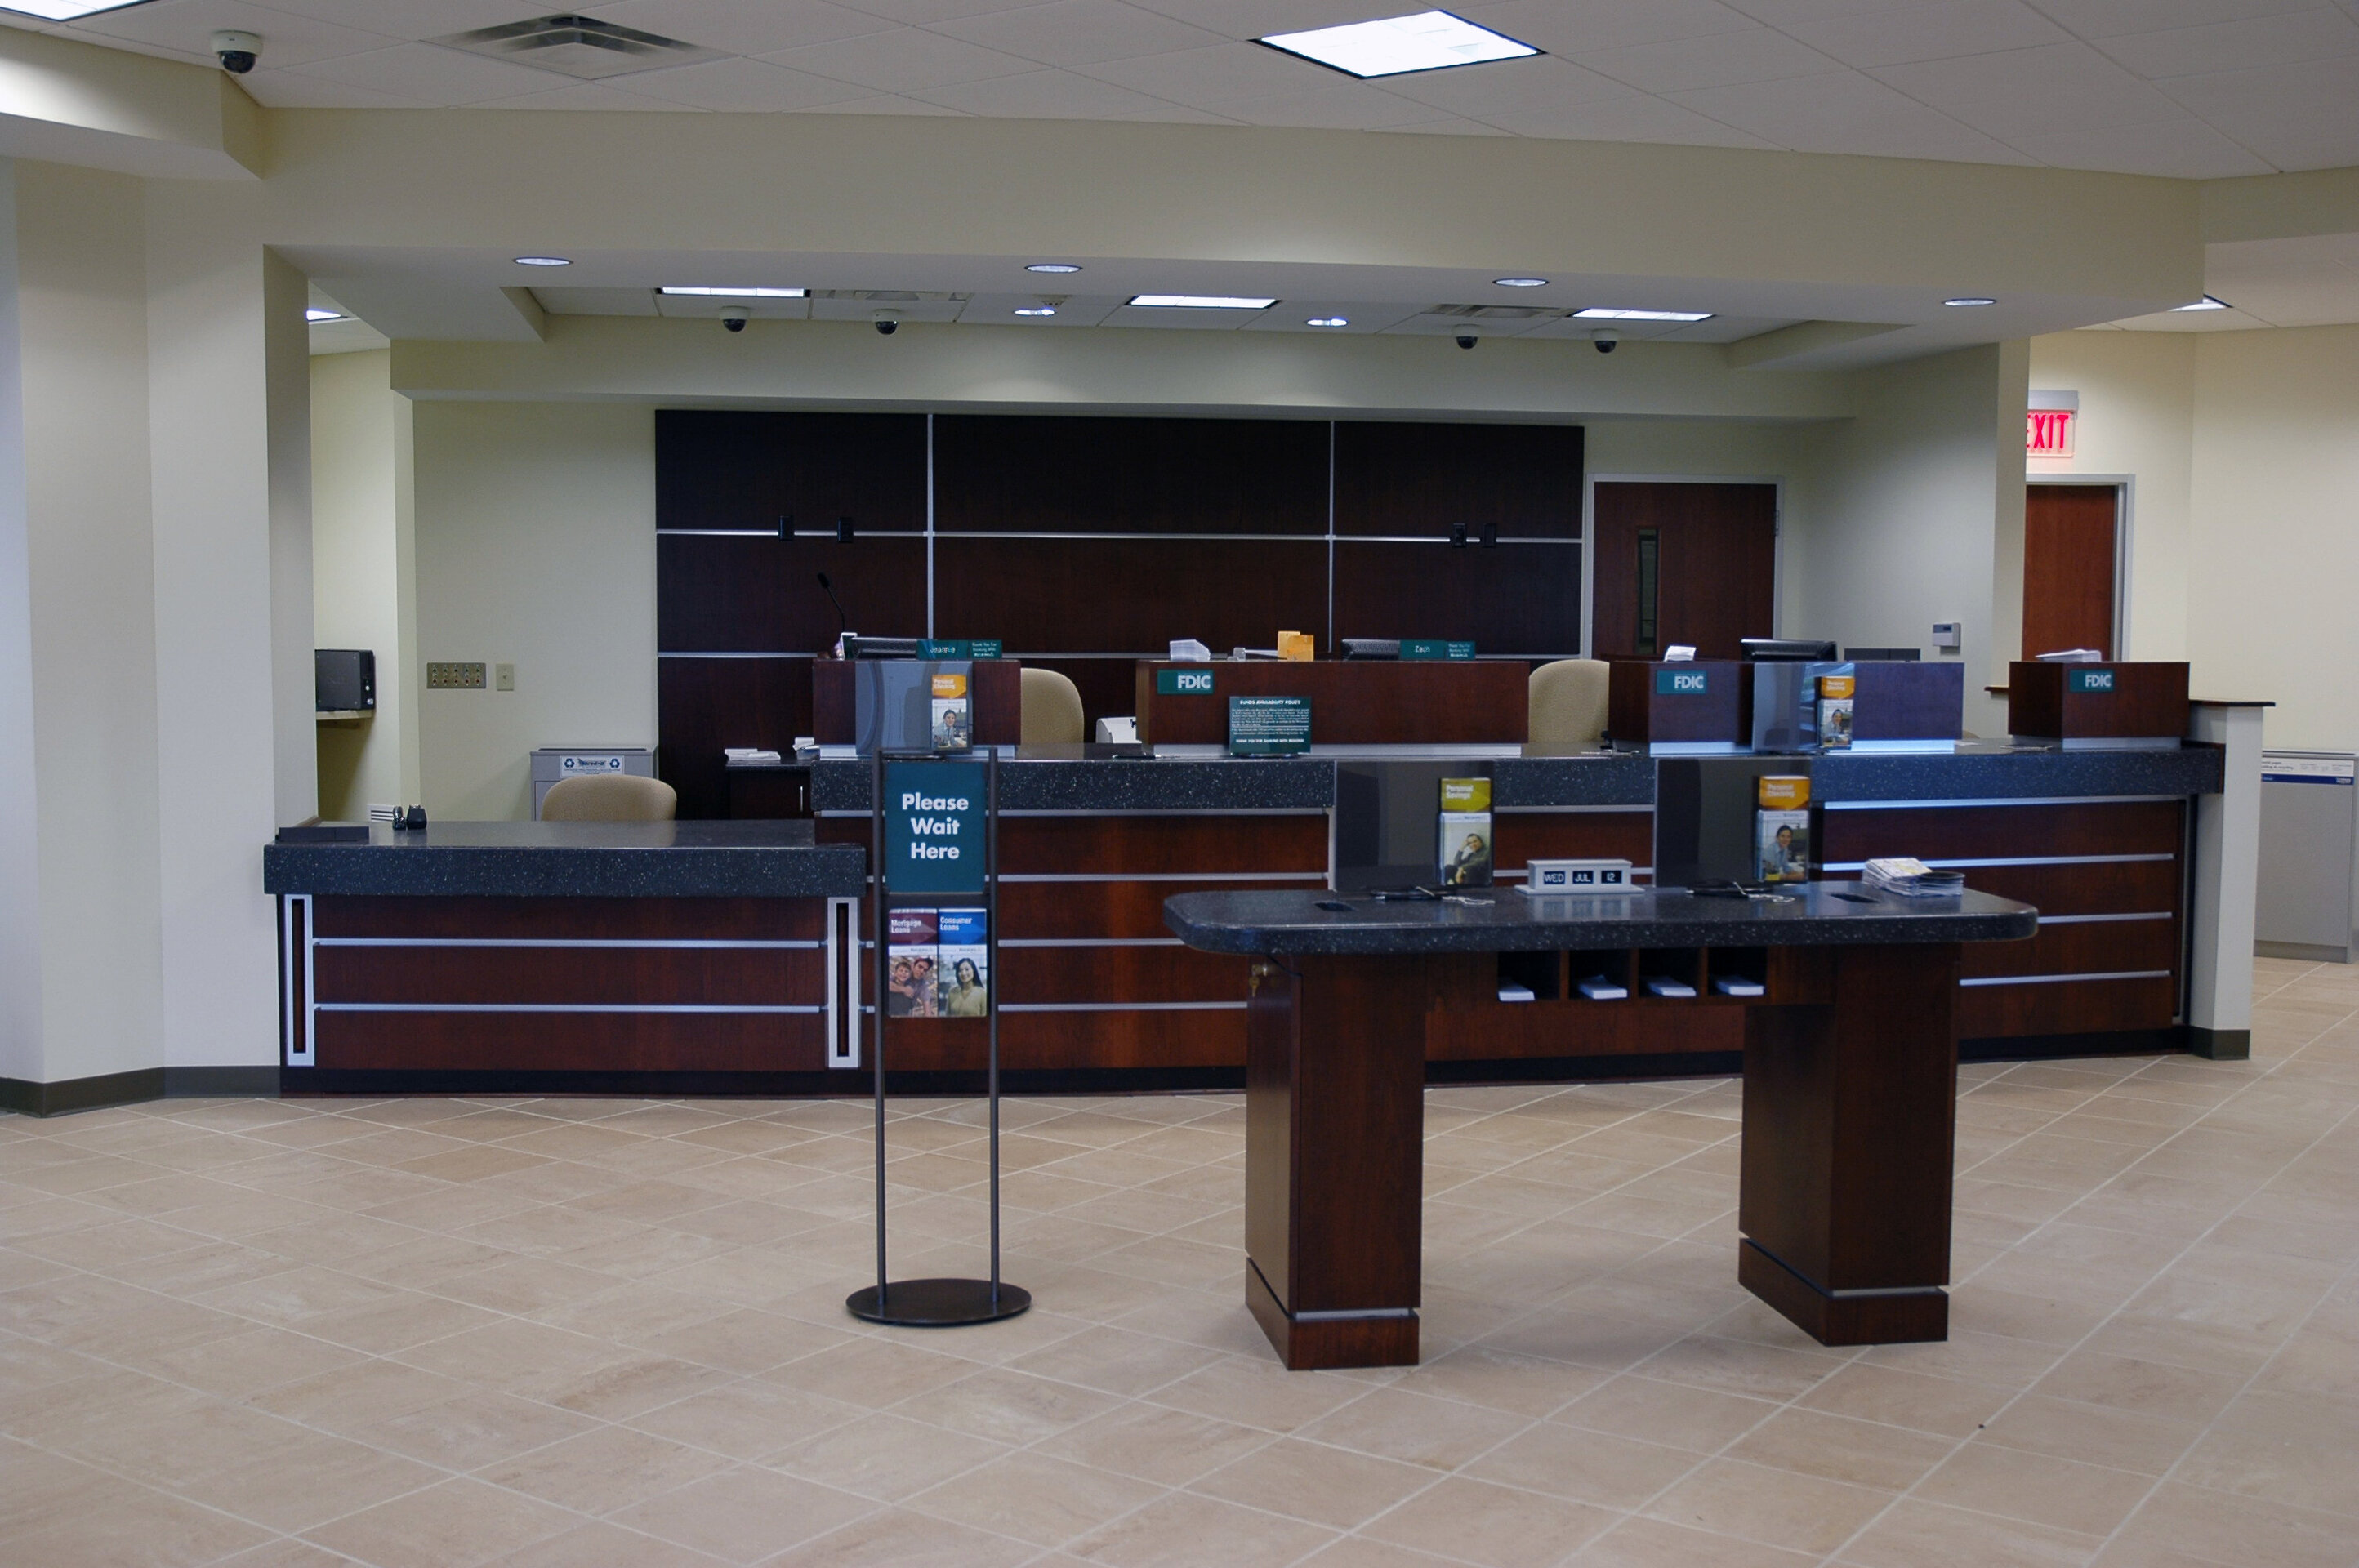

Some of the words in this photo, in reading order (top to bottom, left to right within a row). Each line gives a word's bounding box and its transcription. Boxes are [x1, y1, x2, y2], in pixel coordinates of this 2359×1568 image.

[1177, 675, 1211, 688] FDIC
[1674, 675, 1704, 688] FDIC
[2085, 675, 2112, 687] FDIC
[902, 792, 970, 811] Please
[910, 817, 961, 835] Wait
[911, 842, 960, 859] Here
[1543, 873, 1564, 883] WED
[1574, 873, 1590, 882] JUL
[1606, 872, 1616, 882] 12
[891, 920, 922, 929] Mortgage
